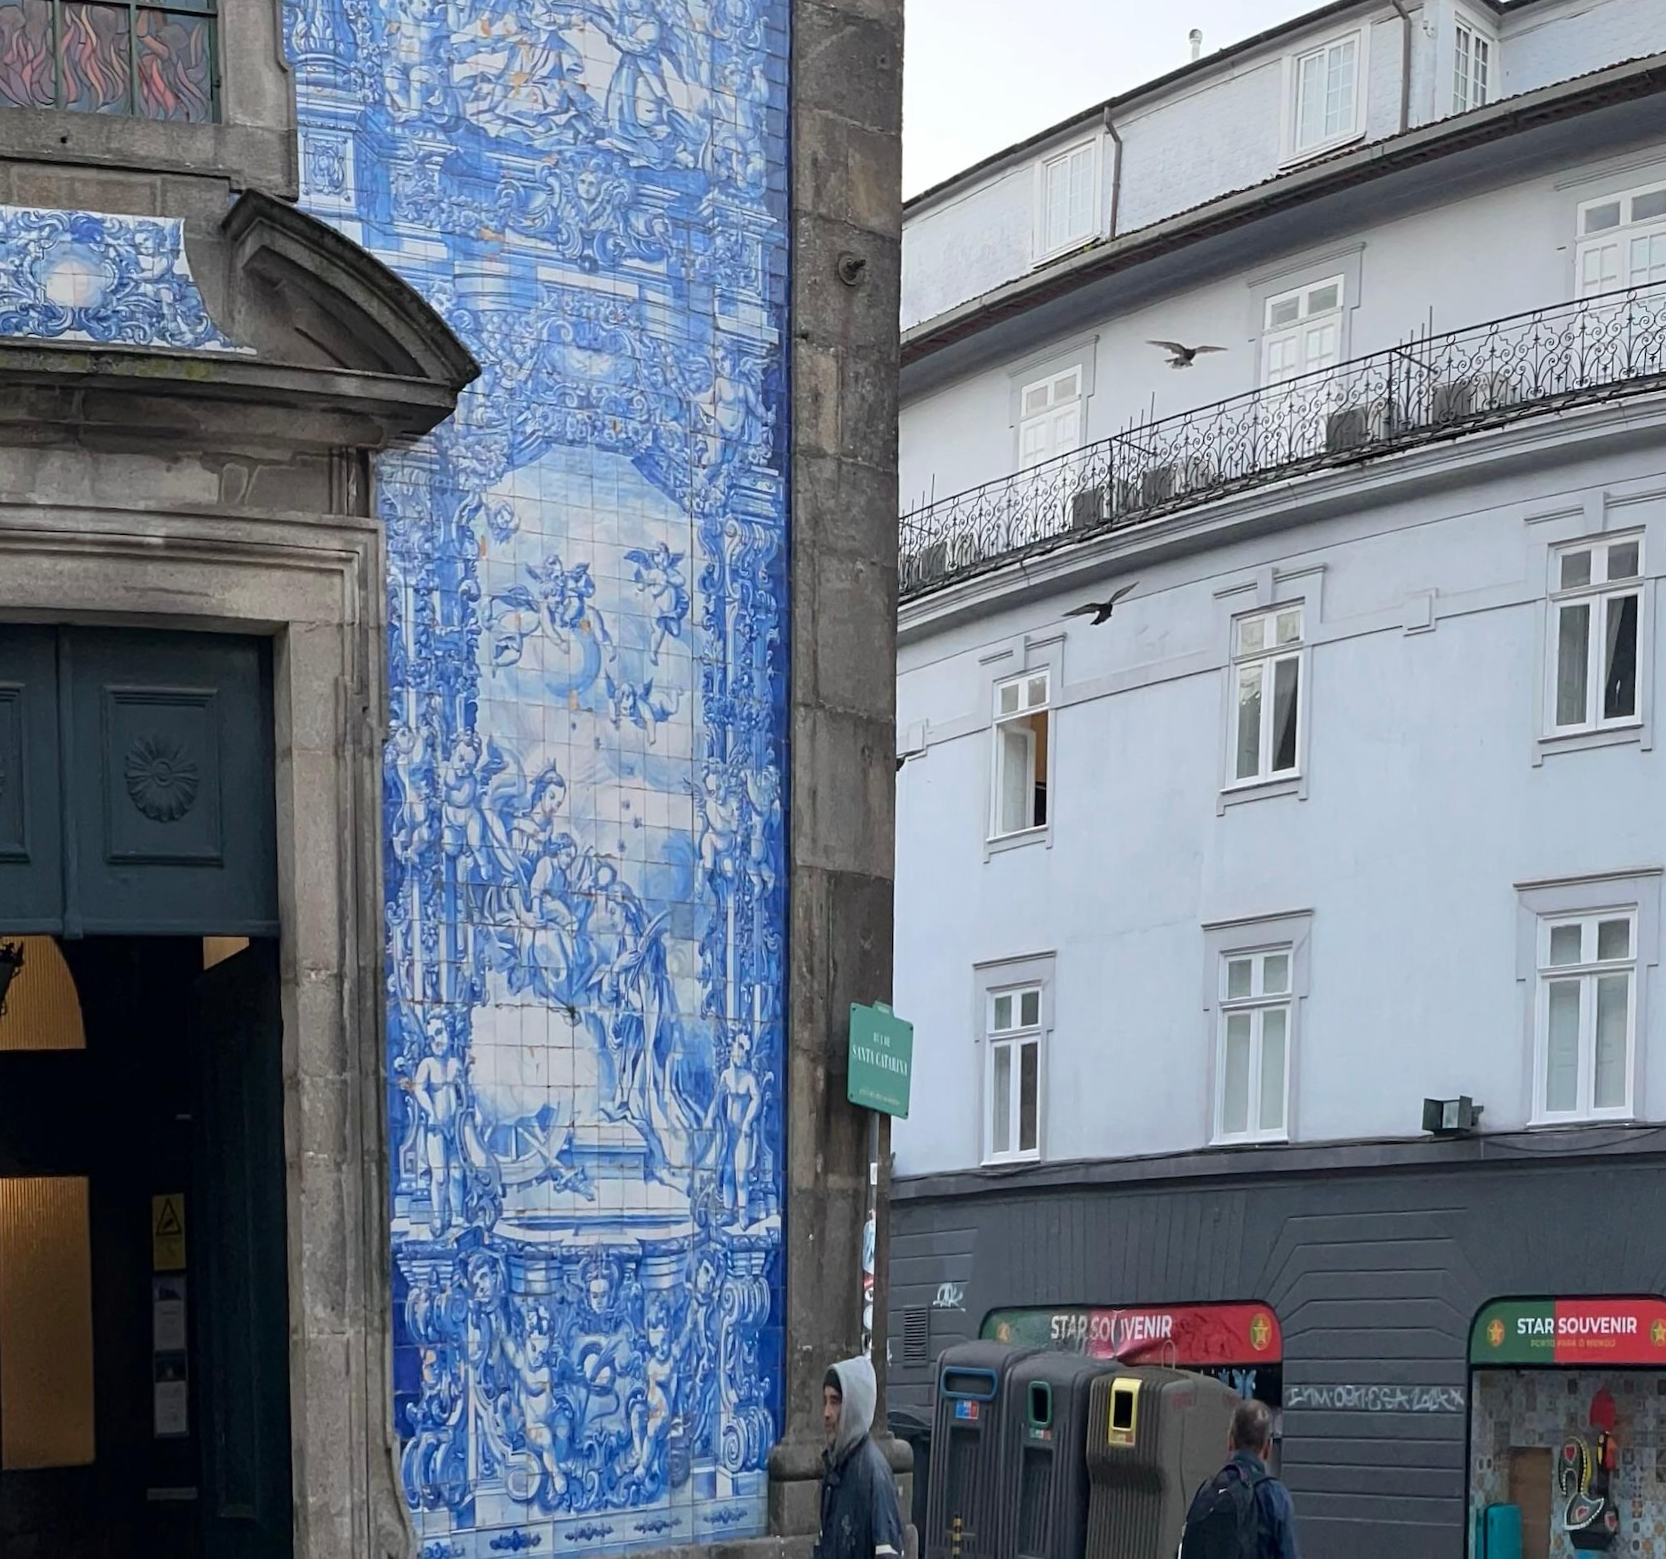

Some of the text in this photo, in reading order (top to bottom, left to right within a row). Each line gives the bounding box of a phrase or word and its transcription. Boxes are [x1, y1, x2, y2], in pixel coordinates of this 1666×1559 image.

[851, 1044, 908, 1077] SANTA CATARINA
[1051, 1315, 1088, 1340] STAR
[1517, 1317, 1637, 1334] STAR SOUVENIR
